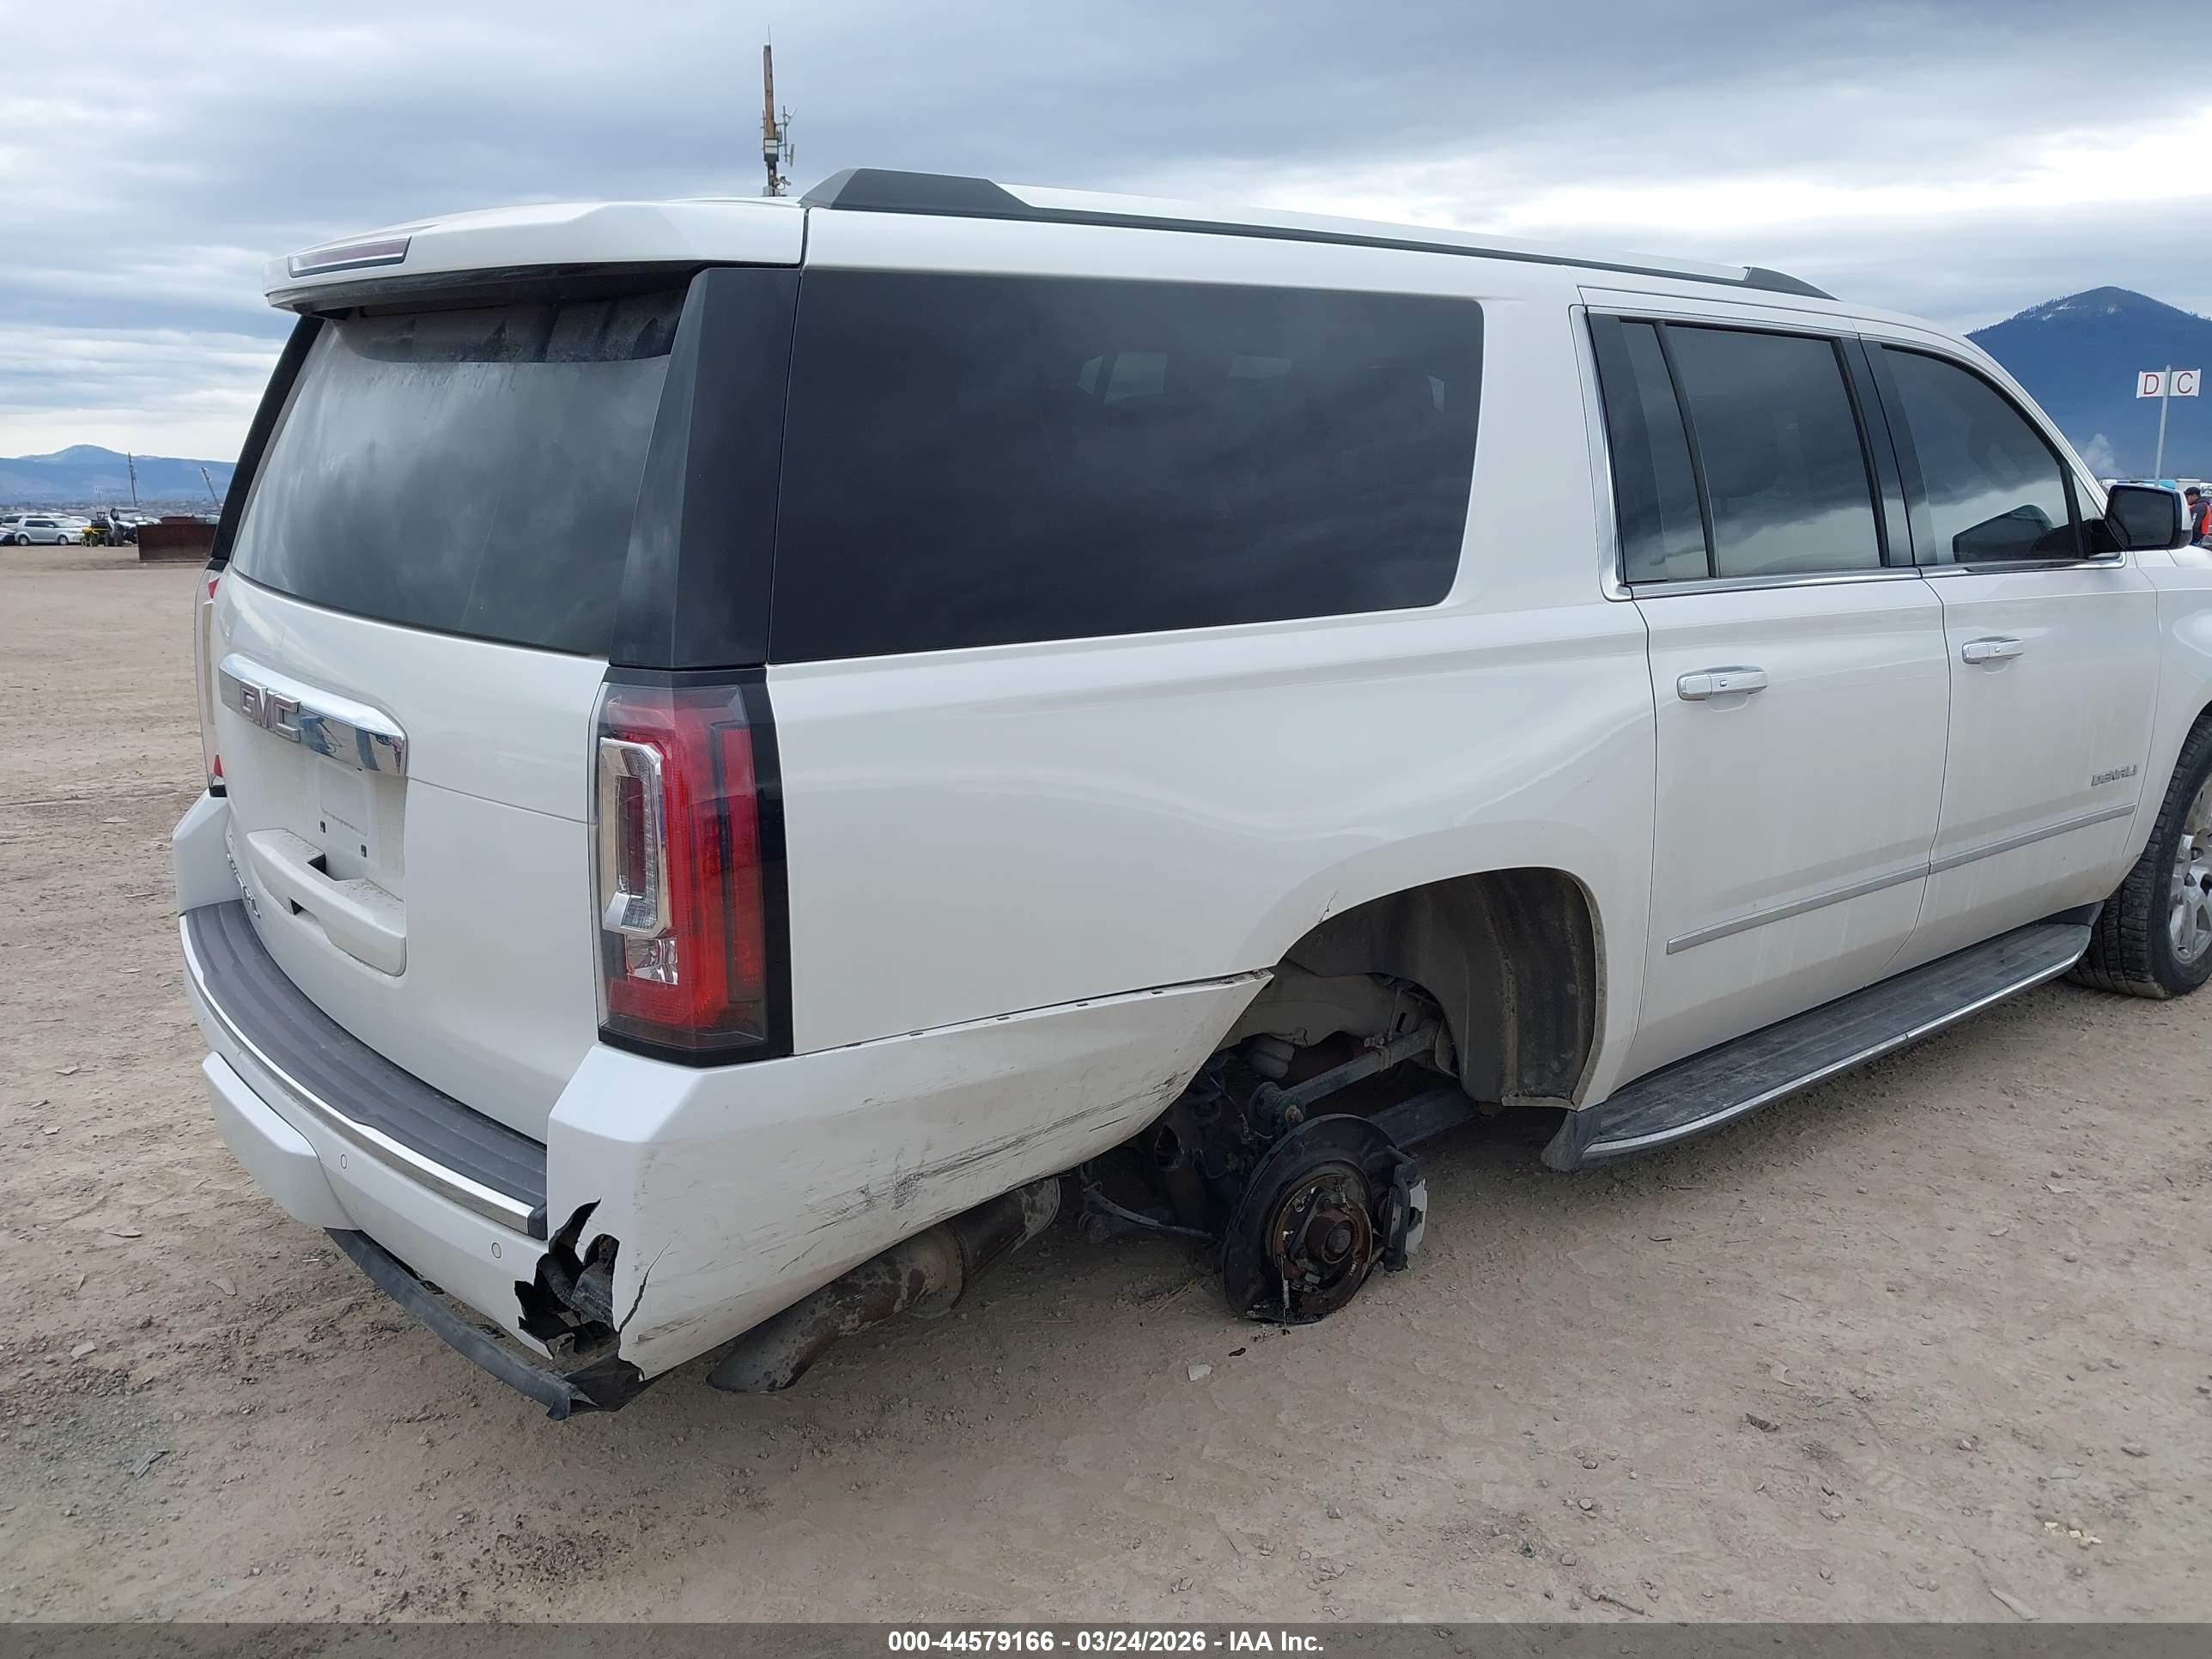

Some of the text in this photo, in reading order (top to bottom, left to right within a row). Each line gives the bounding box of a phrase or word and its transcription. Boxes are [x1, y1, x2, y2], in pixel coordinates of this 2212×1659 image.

[2143, 373, 2193, 394] D C
[240, 679, 302, 744] GMC
